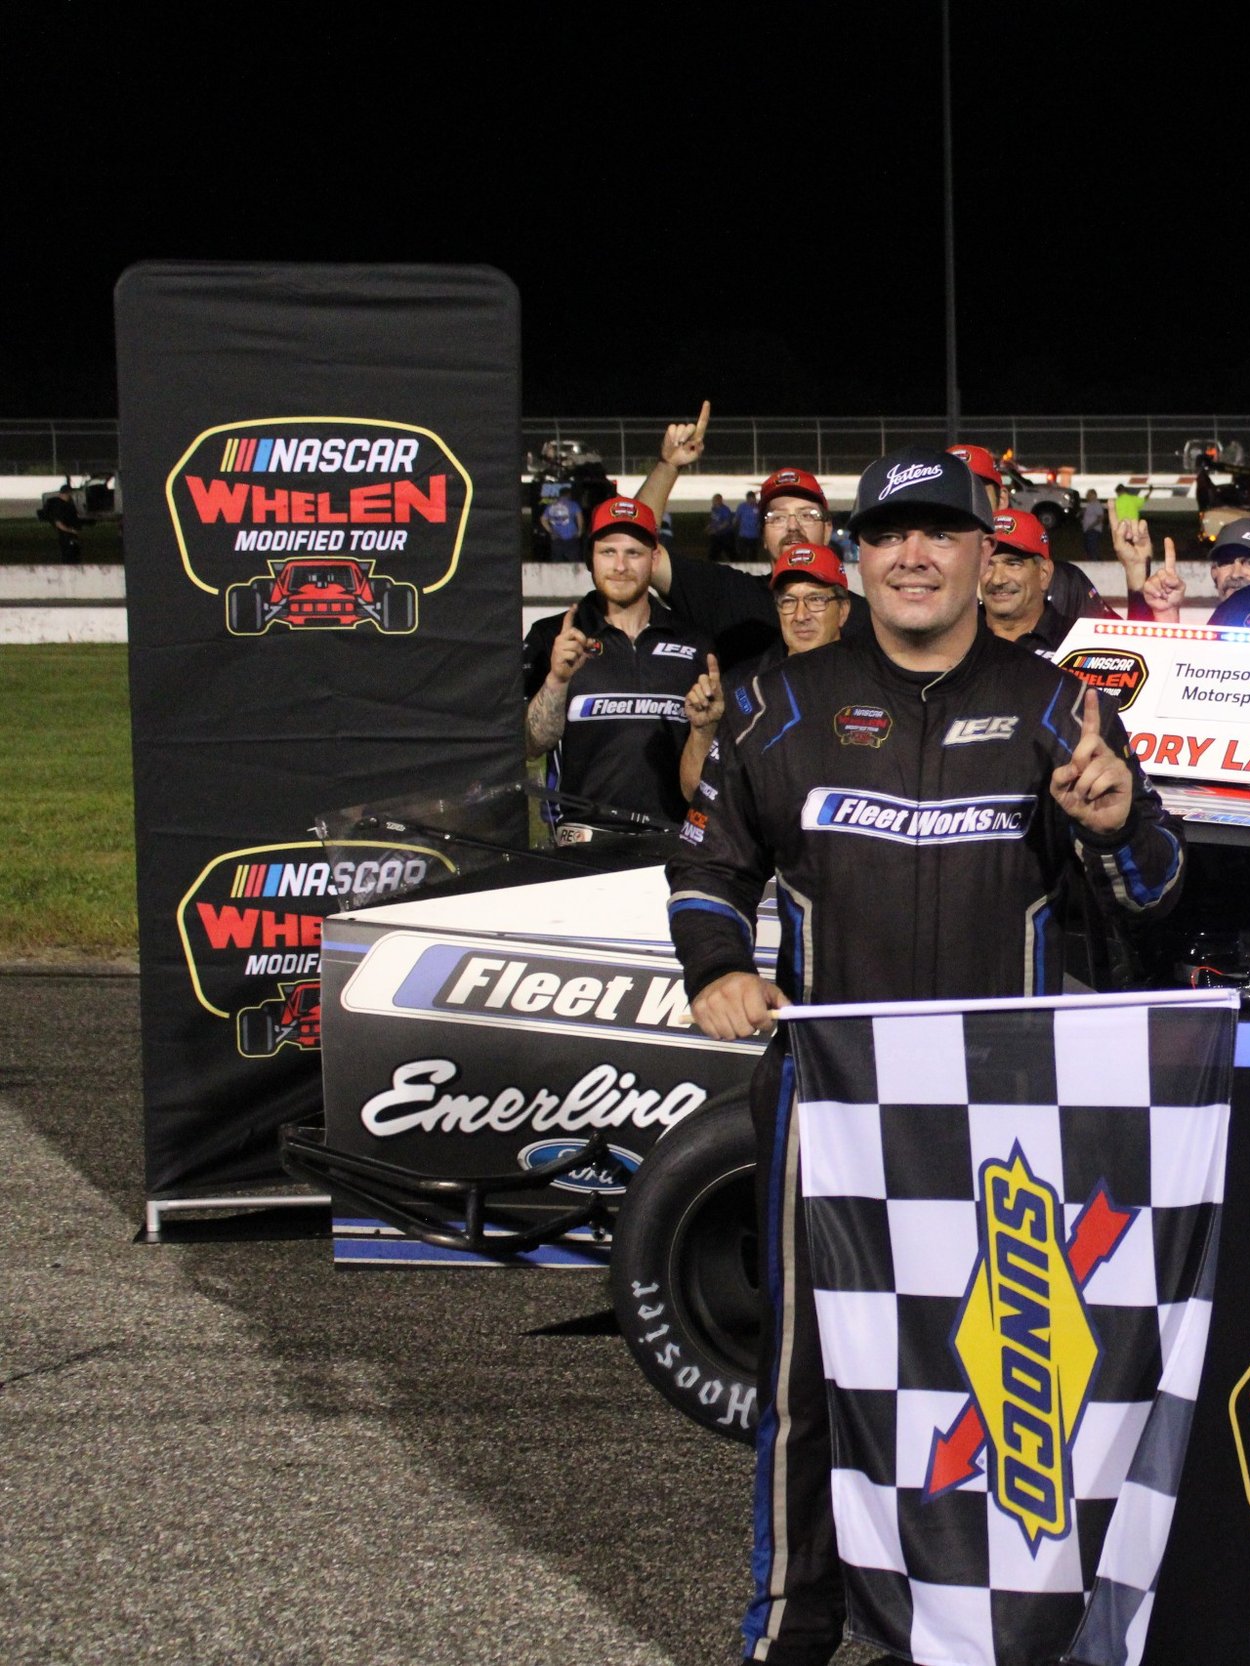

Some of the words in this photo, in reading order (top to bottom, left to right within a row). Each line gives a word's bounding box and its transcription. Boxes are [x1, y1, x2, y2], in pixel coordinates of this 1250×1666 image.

[268, 438, 419, 473] NASCAR
[185, 474, 447, 524] WHELEN
[879, 463, 944, 500] Jostens
[235, 530, 346, 551] MODIFIED
[349, 530, 408, 552] TOUR
[652, 642, 697, 660] LFR
[1087, 656, 1135, 671] NASCAR
[592, 698, 633, 715] Fleet
[634, 699, 681, 716] Works
[943, 715, 1019, 747] LFR
[832, 797, 911, 832] Fleet
[906, 806, 994, 838] Works
[196, 902, 323, 950] WHE
[245, 954, 322, 976] MODIF
[445, 956, 635, 1021] Fleet
[632, 1280, 757, 1429] Hoosier
[991, 1174, 1058, 1525] SUNOCO
